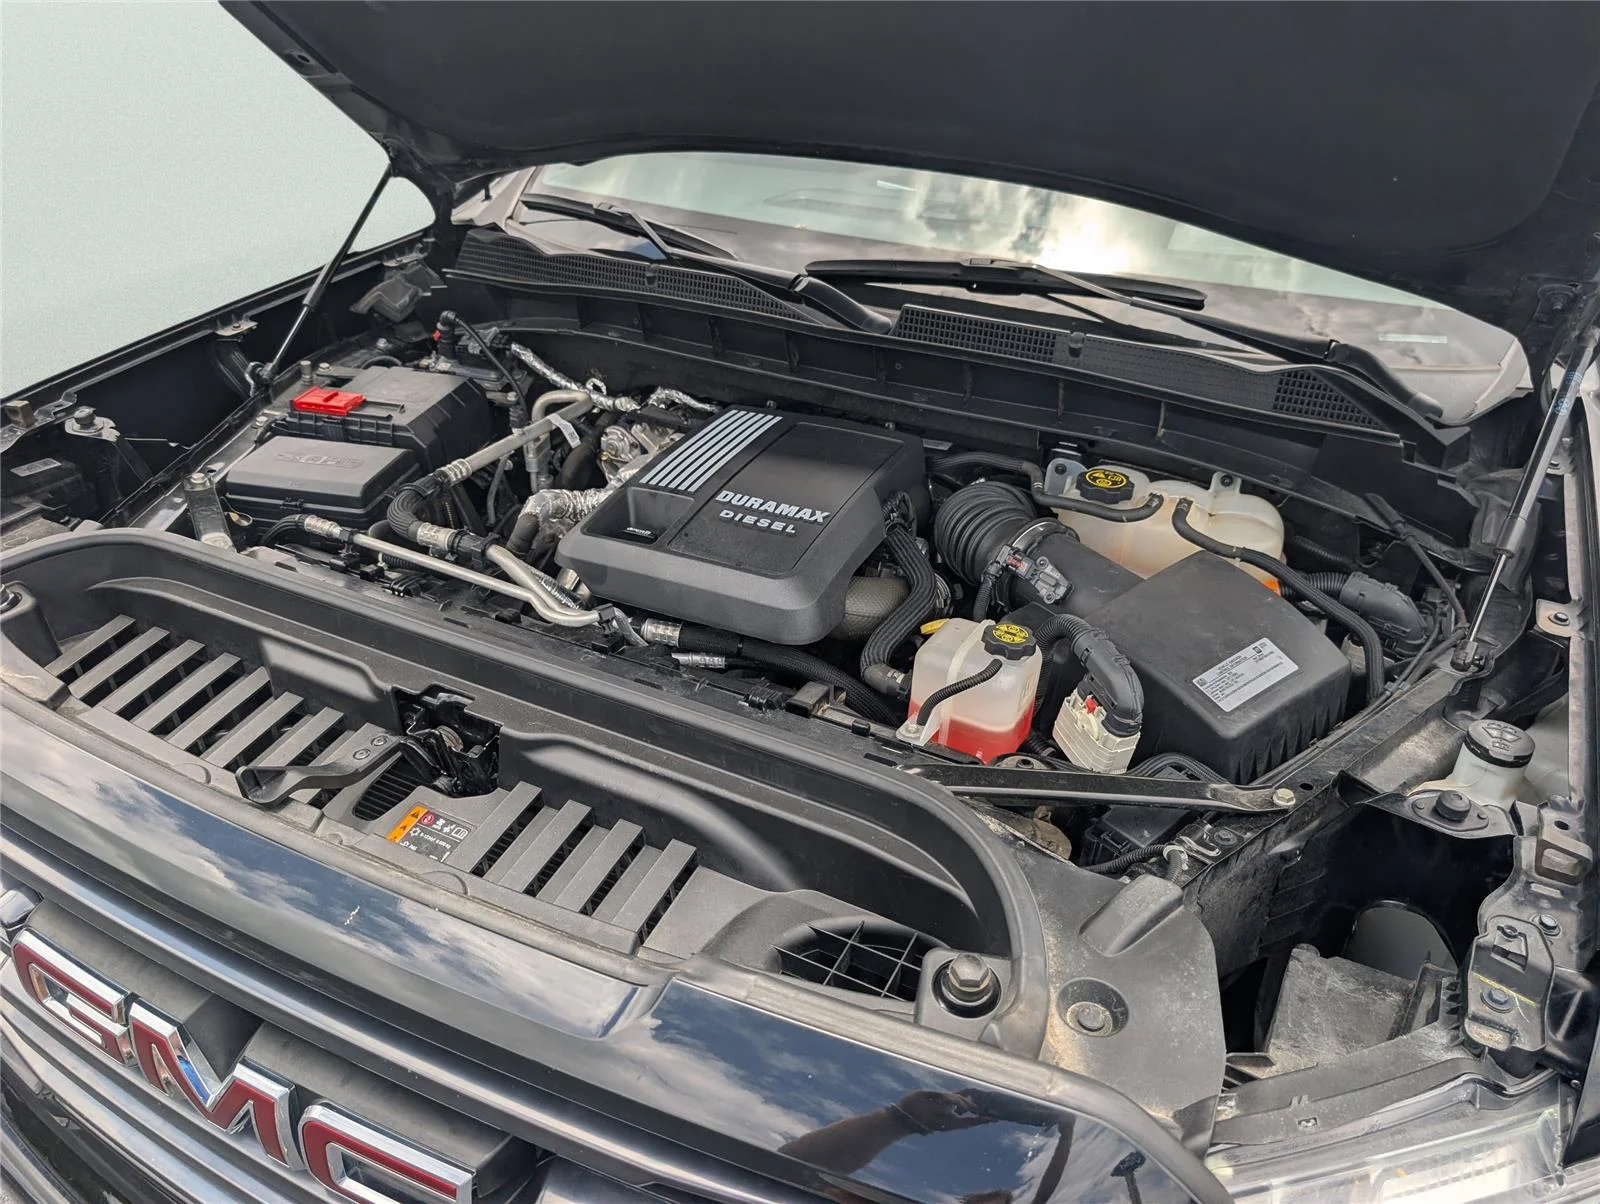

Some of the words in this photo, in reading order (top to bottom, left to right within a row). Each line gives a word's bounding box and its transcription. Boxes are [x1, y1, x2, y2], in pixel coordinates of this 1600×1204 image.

[715, 490, 831, 523] DURAMAX
[719, 509, 797, 534] DIESEL
[11, 927, 475, 1204] GMC
